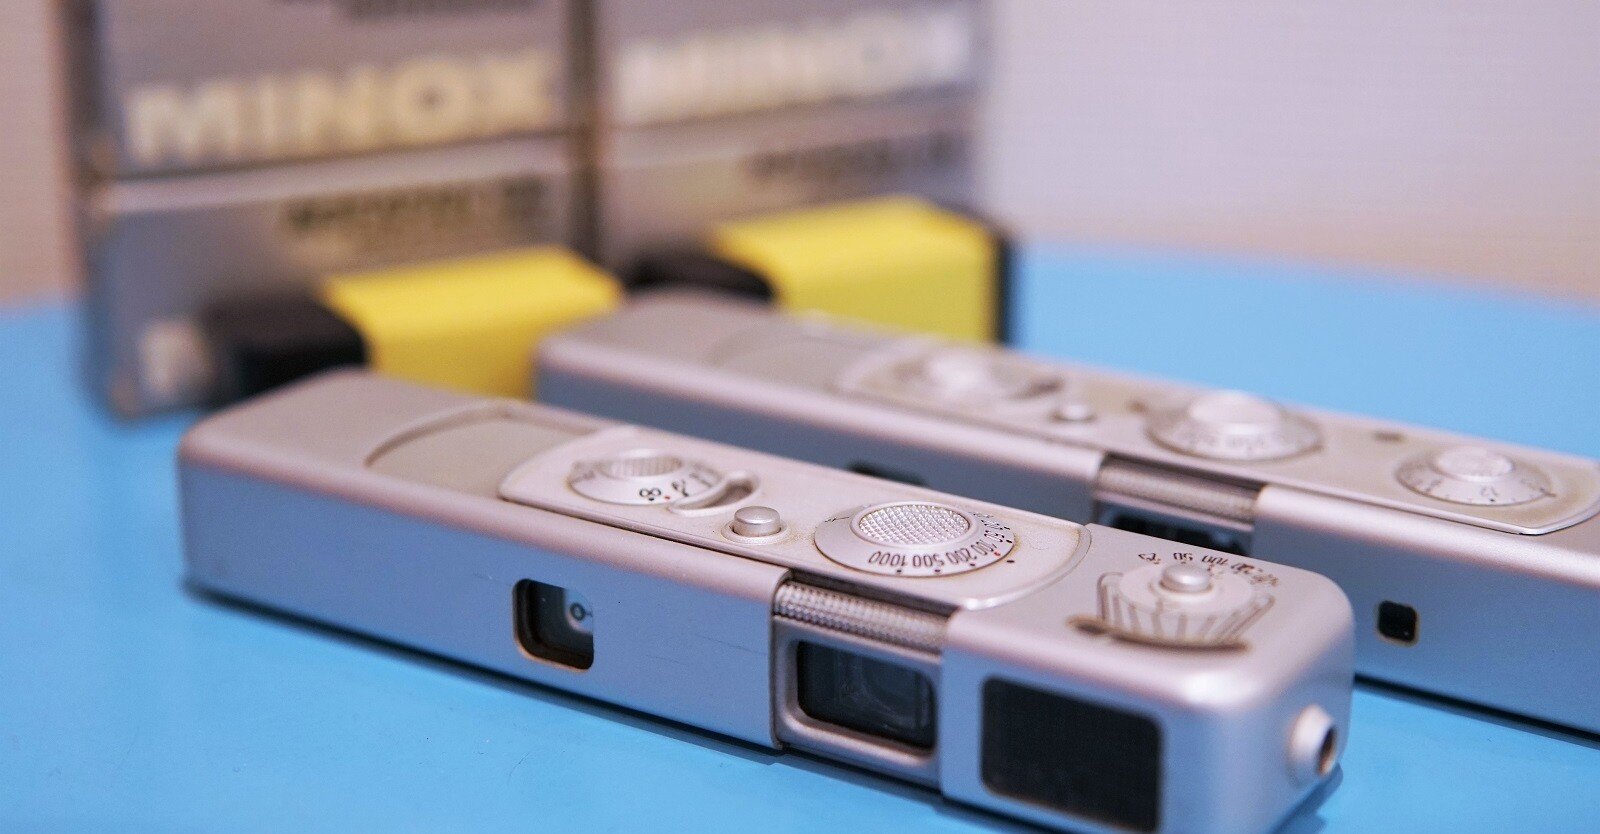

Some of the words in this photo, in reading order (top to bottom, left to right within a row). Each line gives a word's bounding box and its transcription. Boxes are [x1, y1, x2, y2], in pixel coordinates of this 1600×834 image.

[126, 50, 555, 163] MINOX
[868, 551, 908, 568] 1000
[912, 553, 945, 568] 500
[945, 548, 977, 566] 200
